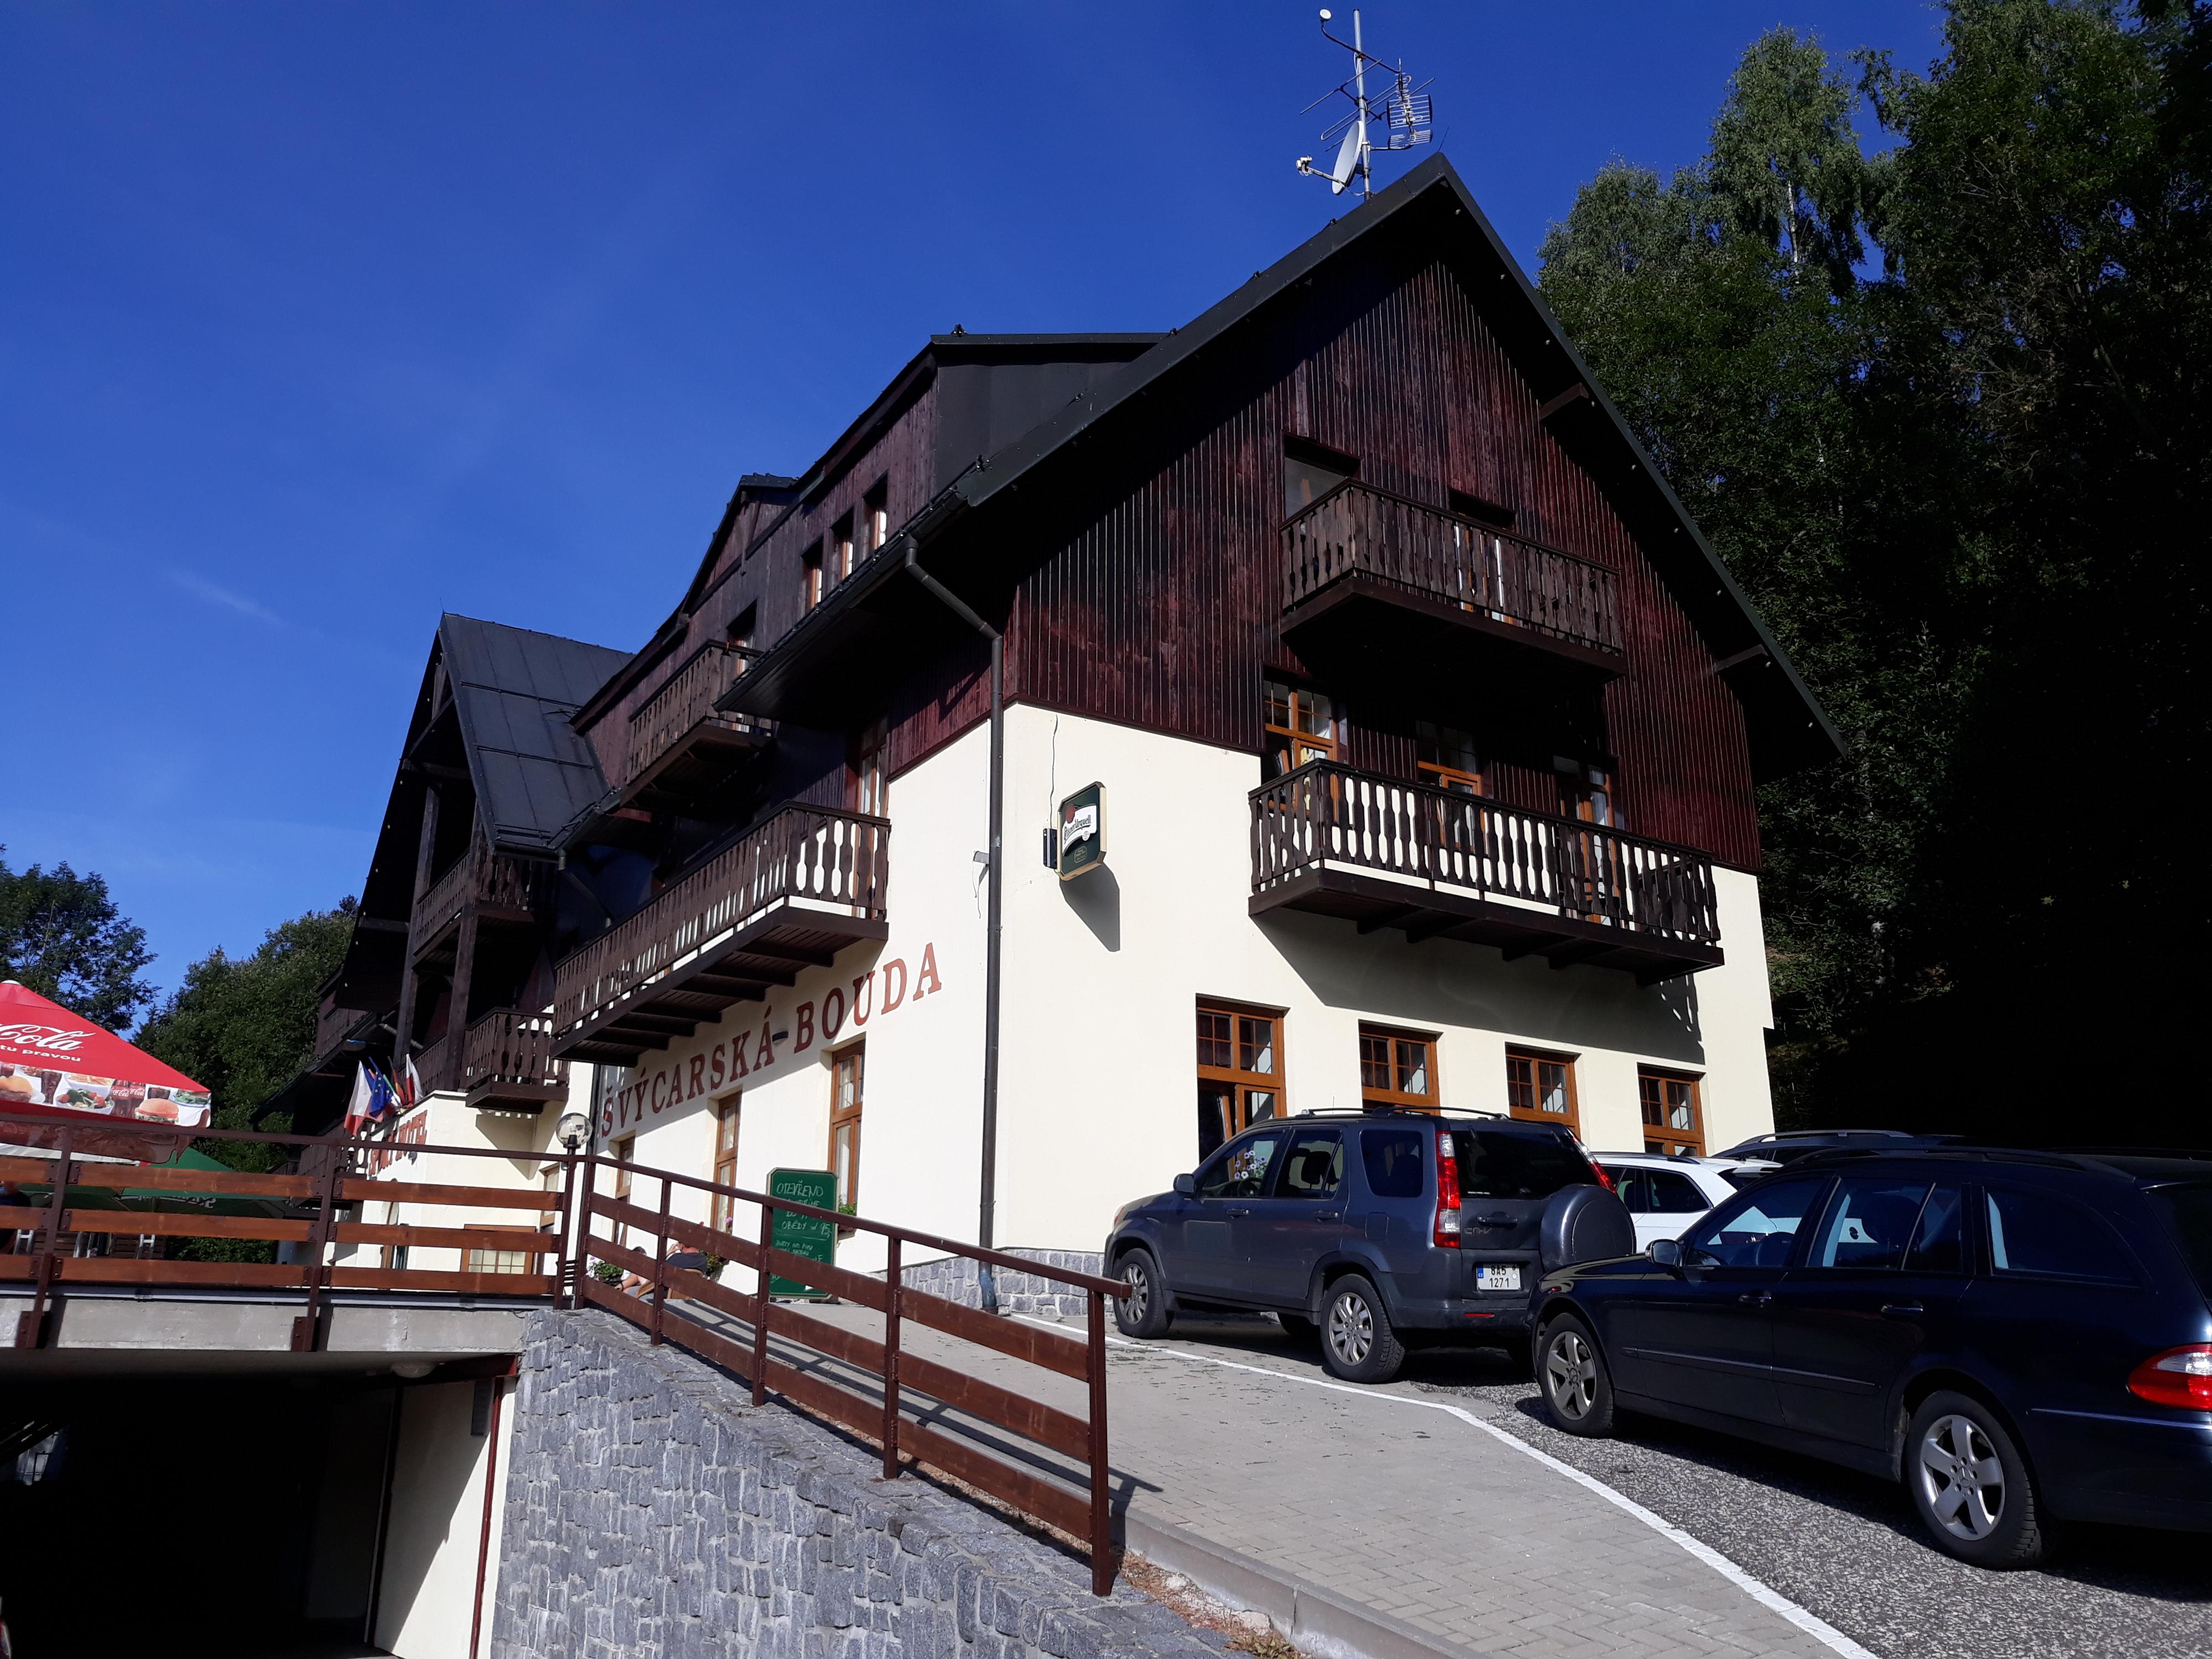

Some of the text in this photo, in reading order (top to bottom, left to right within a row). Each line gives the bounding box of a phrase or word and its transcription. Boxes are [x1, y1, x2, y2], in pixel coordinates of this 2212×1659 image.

[601, 942, 942, 1138] ŠVÝCARSKÁ BOUDA
[22, 1049, 81, 1062] pravou
[776, 1180, 824, 1198] OTEVŘENO
[1491, 1265, 1506, 1276] 8A5
[1489, 1277, 1509, 1288] 1271
